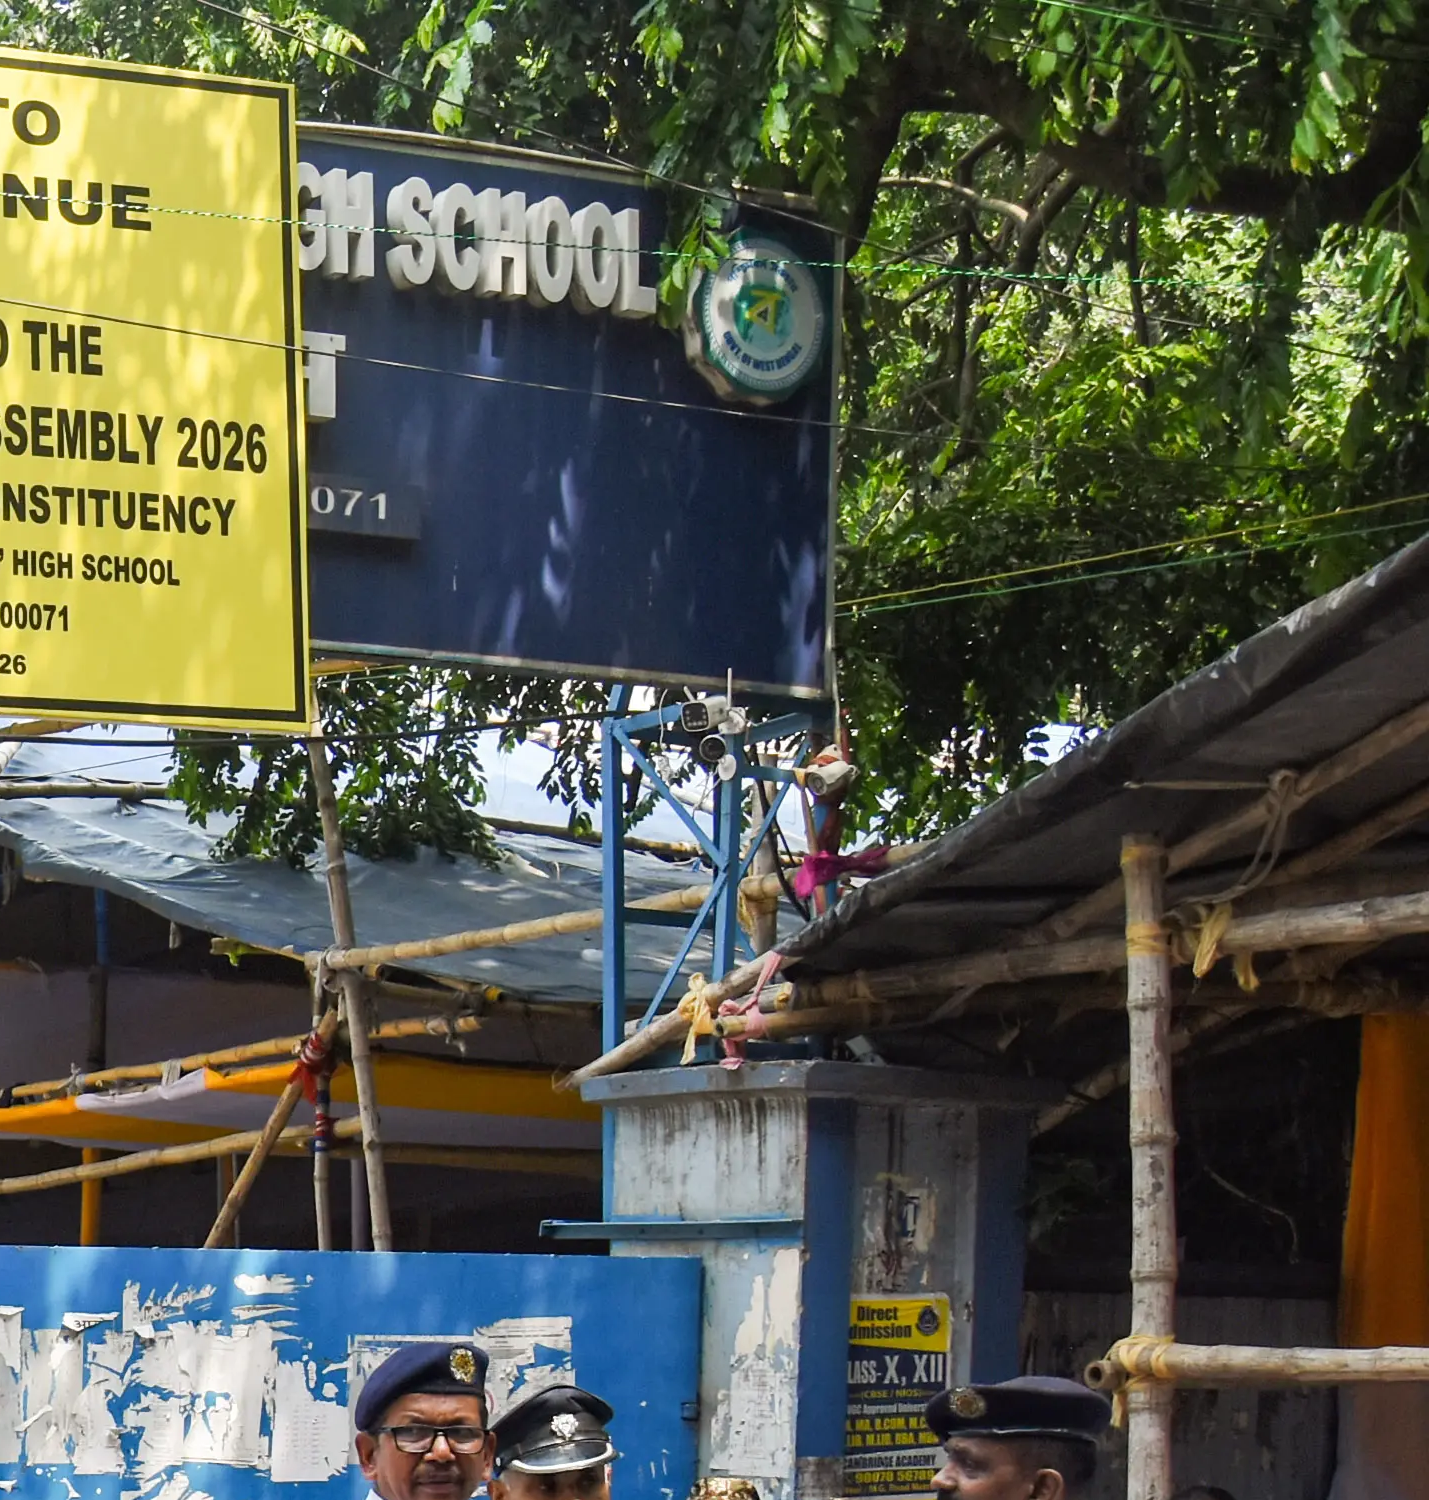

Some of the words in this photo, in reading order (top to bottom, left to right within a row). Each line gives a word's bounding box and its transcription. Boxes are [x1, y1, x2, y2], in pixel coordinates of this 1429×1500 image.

[386, 176, 656, 319] SCHOOL
[22, 320, 103, 376] THE
[177, 417, 268, 473] 2026
[13, 549, 74, 579] HIGH
[82, 554, 180, 587] SCHOOL
[857, 1306, 898, 1321] Direct
[913, 1354, 944, 1383] XII
